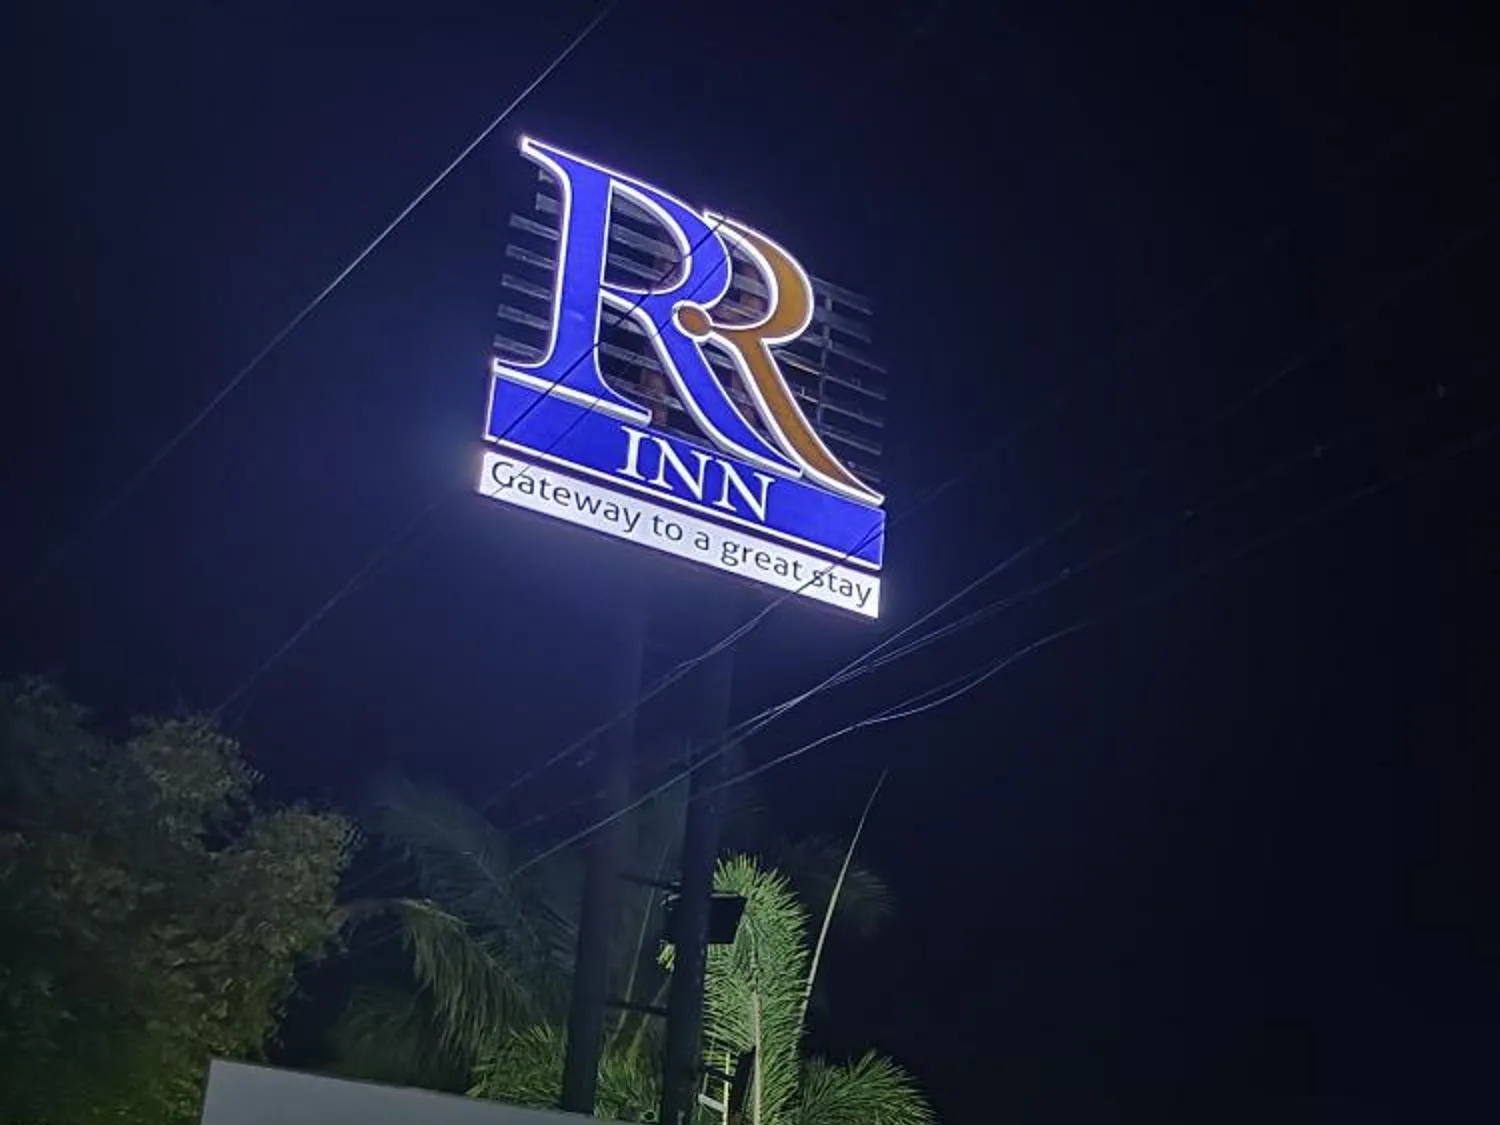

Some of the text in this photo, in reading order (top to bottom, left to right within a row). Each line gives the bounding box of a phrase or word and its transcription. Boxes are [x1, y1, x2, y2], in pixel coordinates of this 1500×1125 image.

[490, 458, 873, 608] Gateway to a great stay
[617, 424, 776, 523] INN
